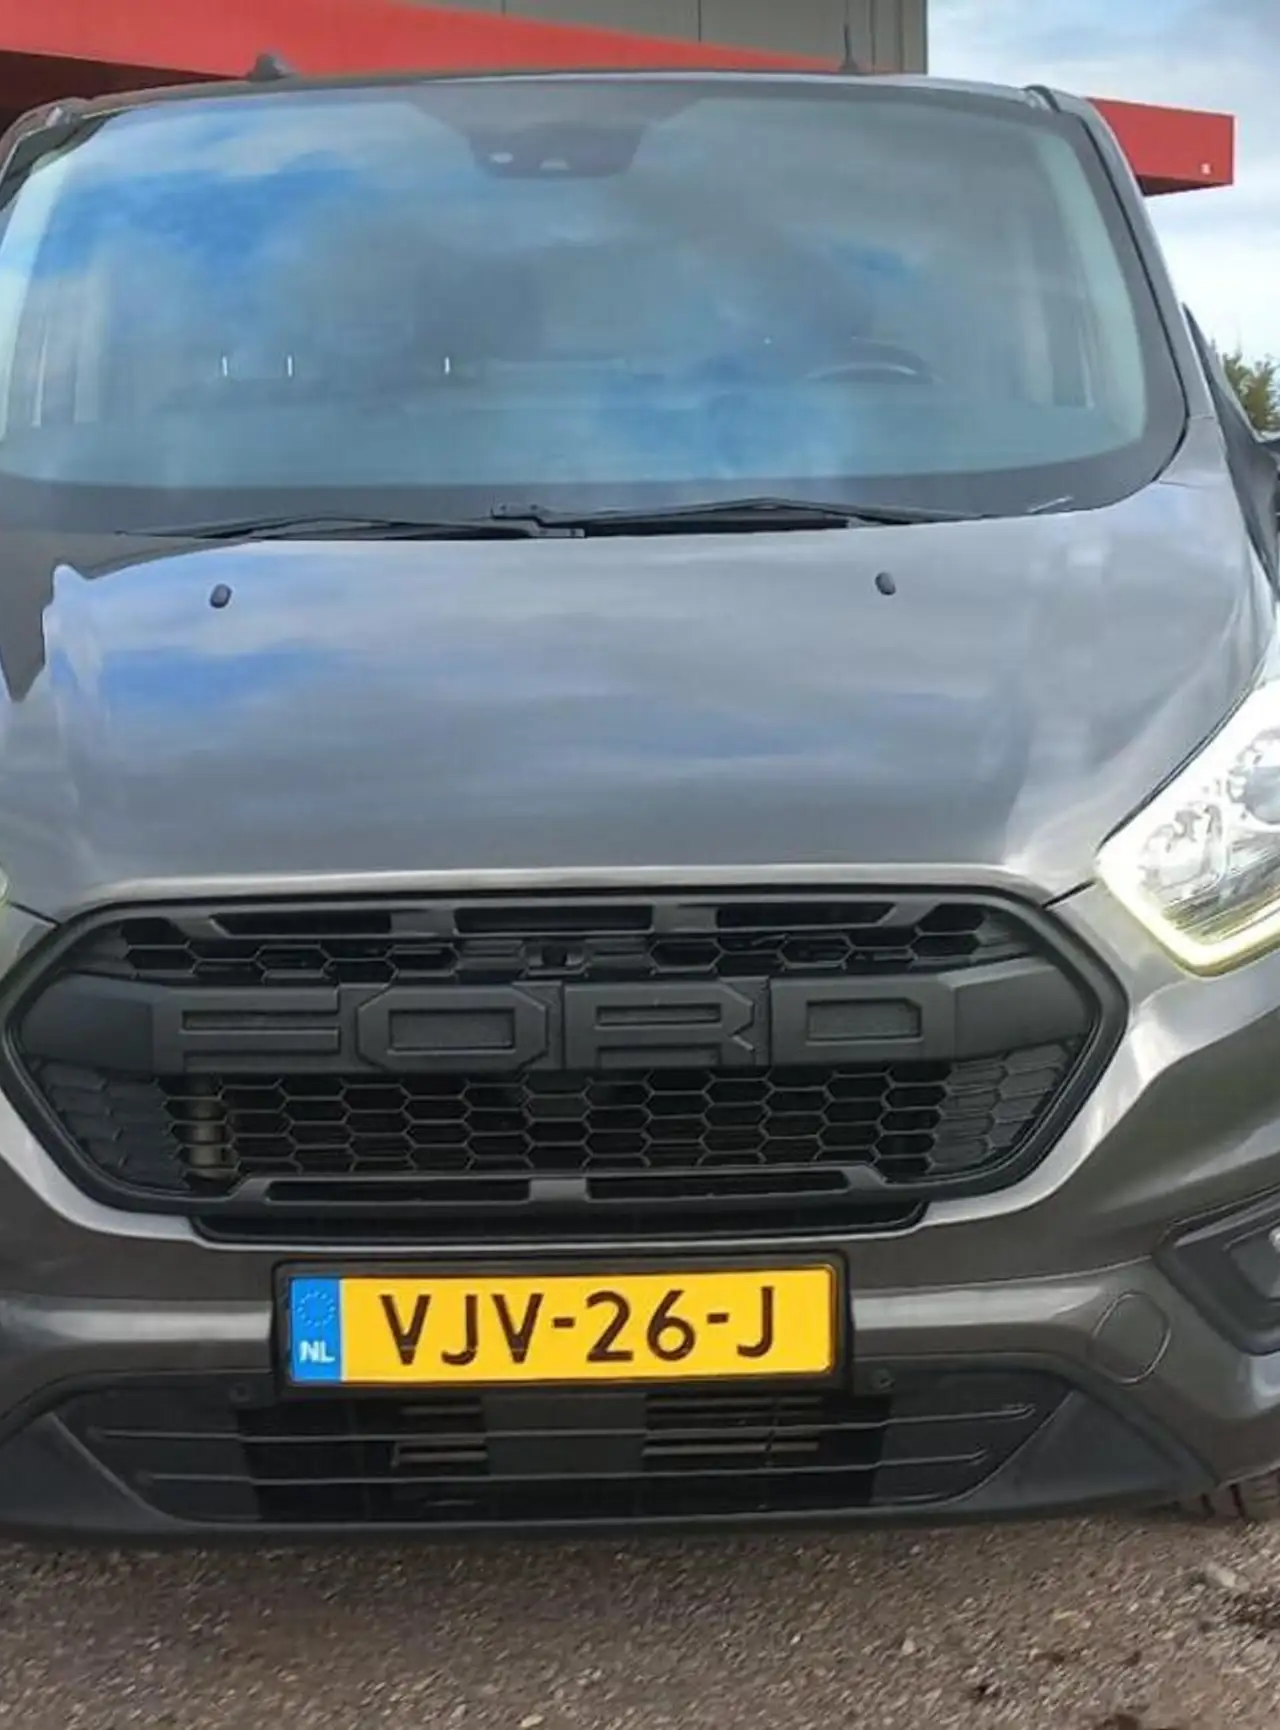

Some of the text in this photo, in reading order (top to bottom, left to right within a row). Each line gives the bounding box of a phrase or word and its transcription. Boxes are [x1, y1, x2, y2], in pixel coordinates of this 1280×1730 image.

[153, 973, 955, 1074] FORD
[297, 1341, 335, 1364] NL
[380, 1286, 775, 1365] VJV-26-J
